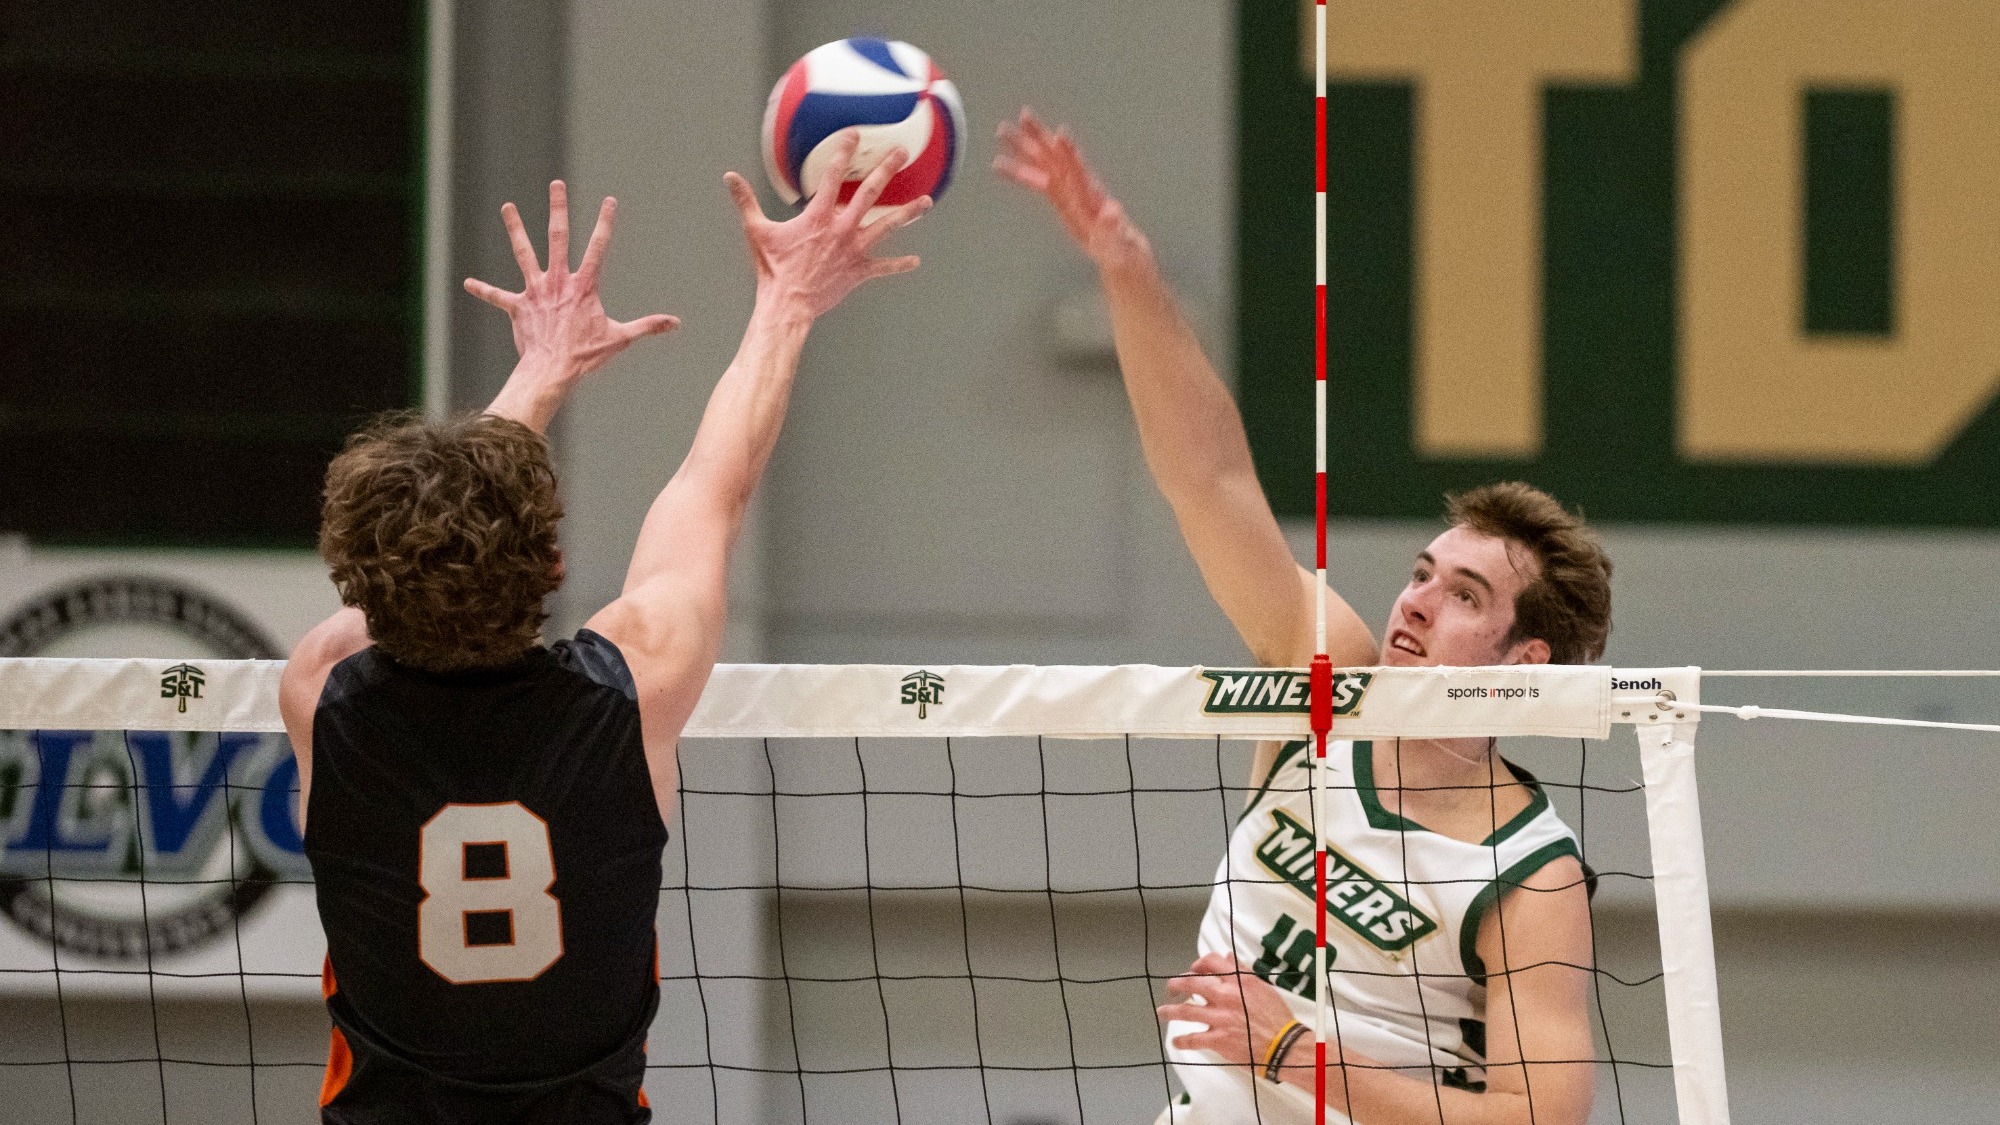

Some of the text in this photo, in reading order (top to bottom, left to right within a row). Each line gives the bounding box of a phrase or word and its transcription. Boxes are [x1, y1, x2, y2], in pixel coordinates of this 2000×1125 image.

[161, 675, 205, 698] S&T
[901, 681, 945, 705] S&T
[1212, 675, 1366, 707] MINES
[1447, 686, 1488, 700] sports
[418, 801, 564, 985] 8
[1260, 822, 1425, 942] MINERS
